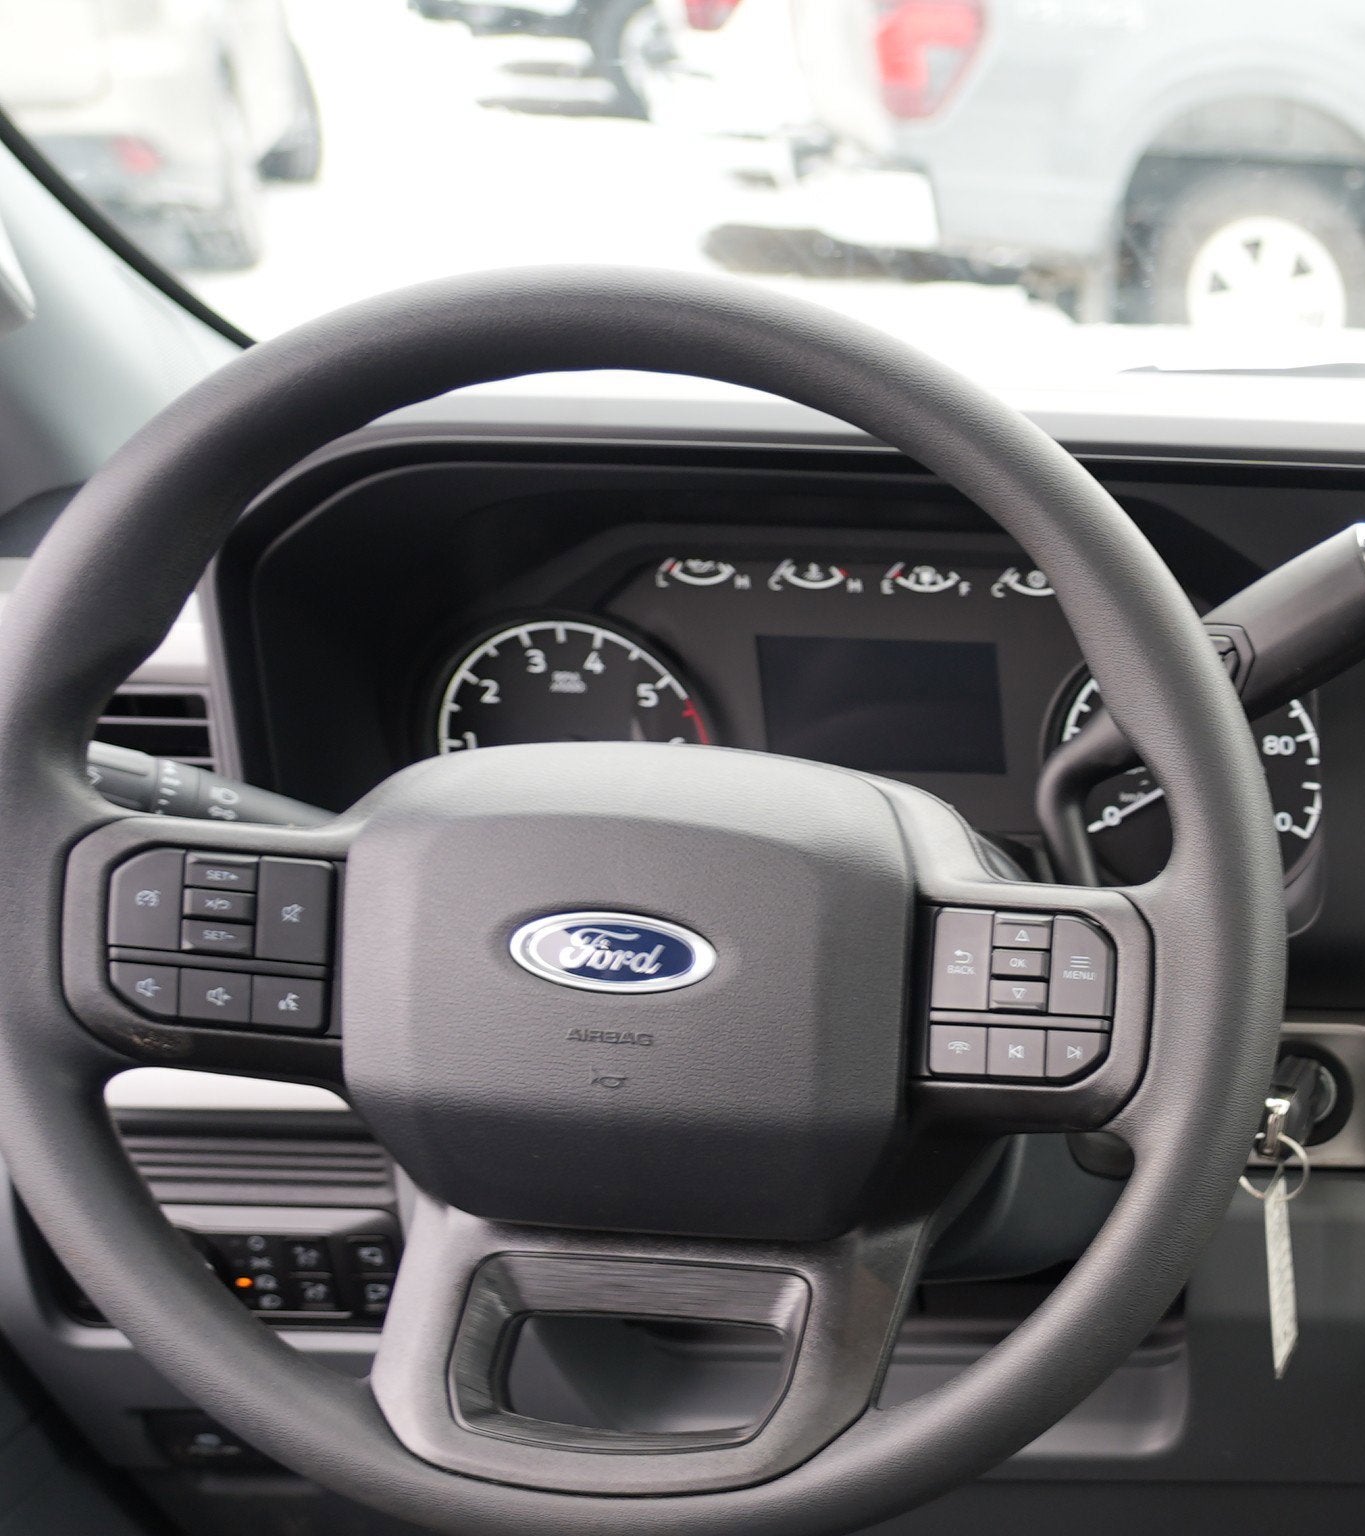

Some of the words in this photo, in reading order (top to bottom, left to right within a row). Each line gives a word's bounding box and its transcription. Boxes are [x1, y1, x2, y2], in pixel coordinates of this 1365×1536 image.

[735, 574, 751, 589] H
[768, 575, 783, 591] C
[847, 577, 863, 593] H
[881, 579, 895, 595] E
[958, 581, 971, 596] F
[990, 581, 1005, 597] C
[526, 650, 548, 674] 3
[583, 650, 605, 674] 4
[479, 679, 501, 704] 2
[636, 683, 660, 708] 5
[1262, 735, 1296, 756] 80
[1103, 805, 1121, 826] 0
[558, 927, 667, 975] Ford
[947, 964, 976, 976] BACK
[1009, 957, 1026, 969] OK
[1062, 970, 1097, 981] MENU
[565, 1027, 655, 1046] AIRBAG
